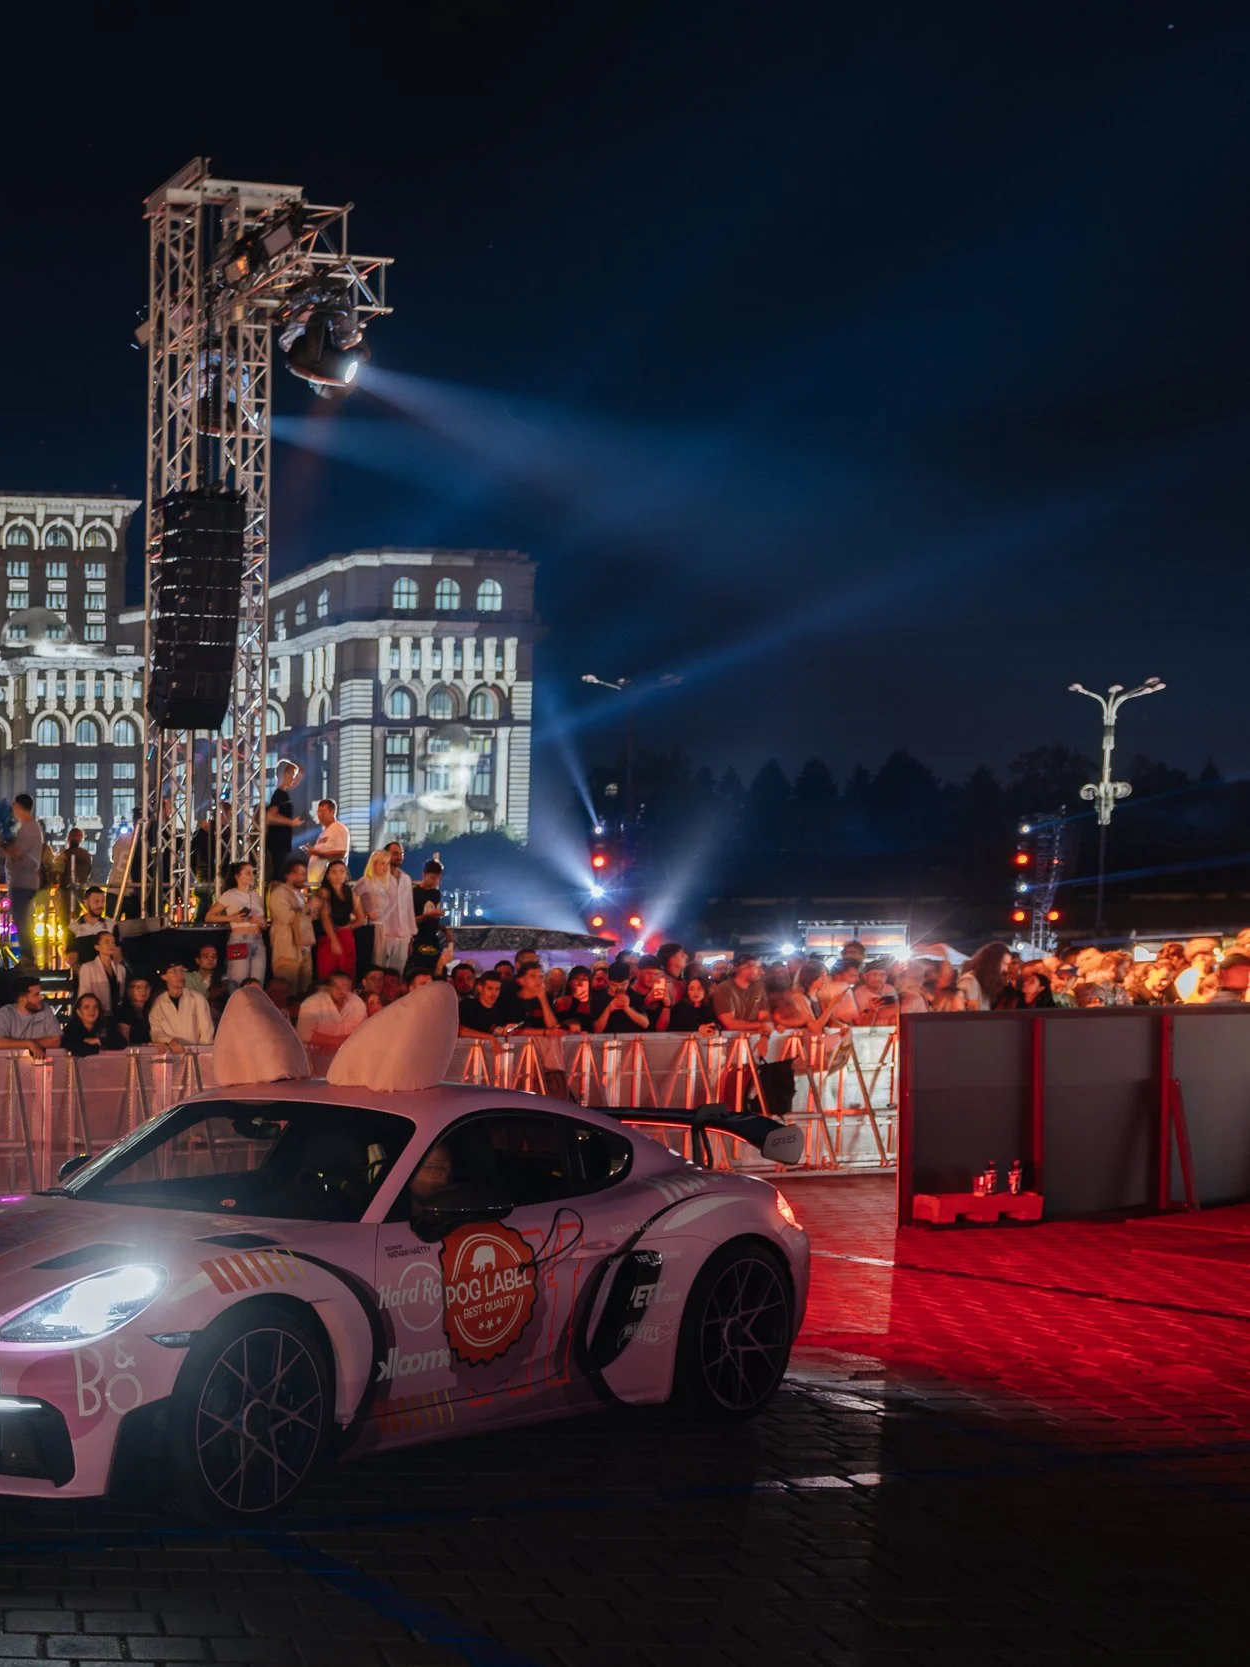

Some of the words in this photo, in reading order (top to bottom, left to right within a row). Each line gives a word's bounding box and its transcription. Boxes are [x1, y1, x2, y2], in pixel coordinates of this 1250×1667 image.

[378, 1279, 420, 1310] Hard
[446, 1278, 481, 1308] POG
[485, 1267, 532, 1297] LABEL
[464, 1304, 483, 1320] BEST
[484, 1294, 517, 1313] QUALITY
